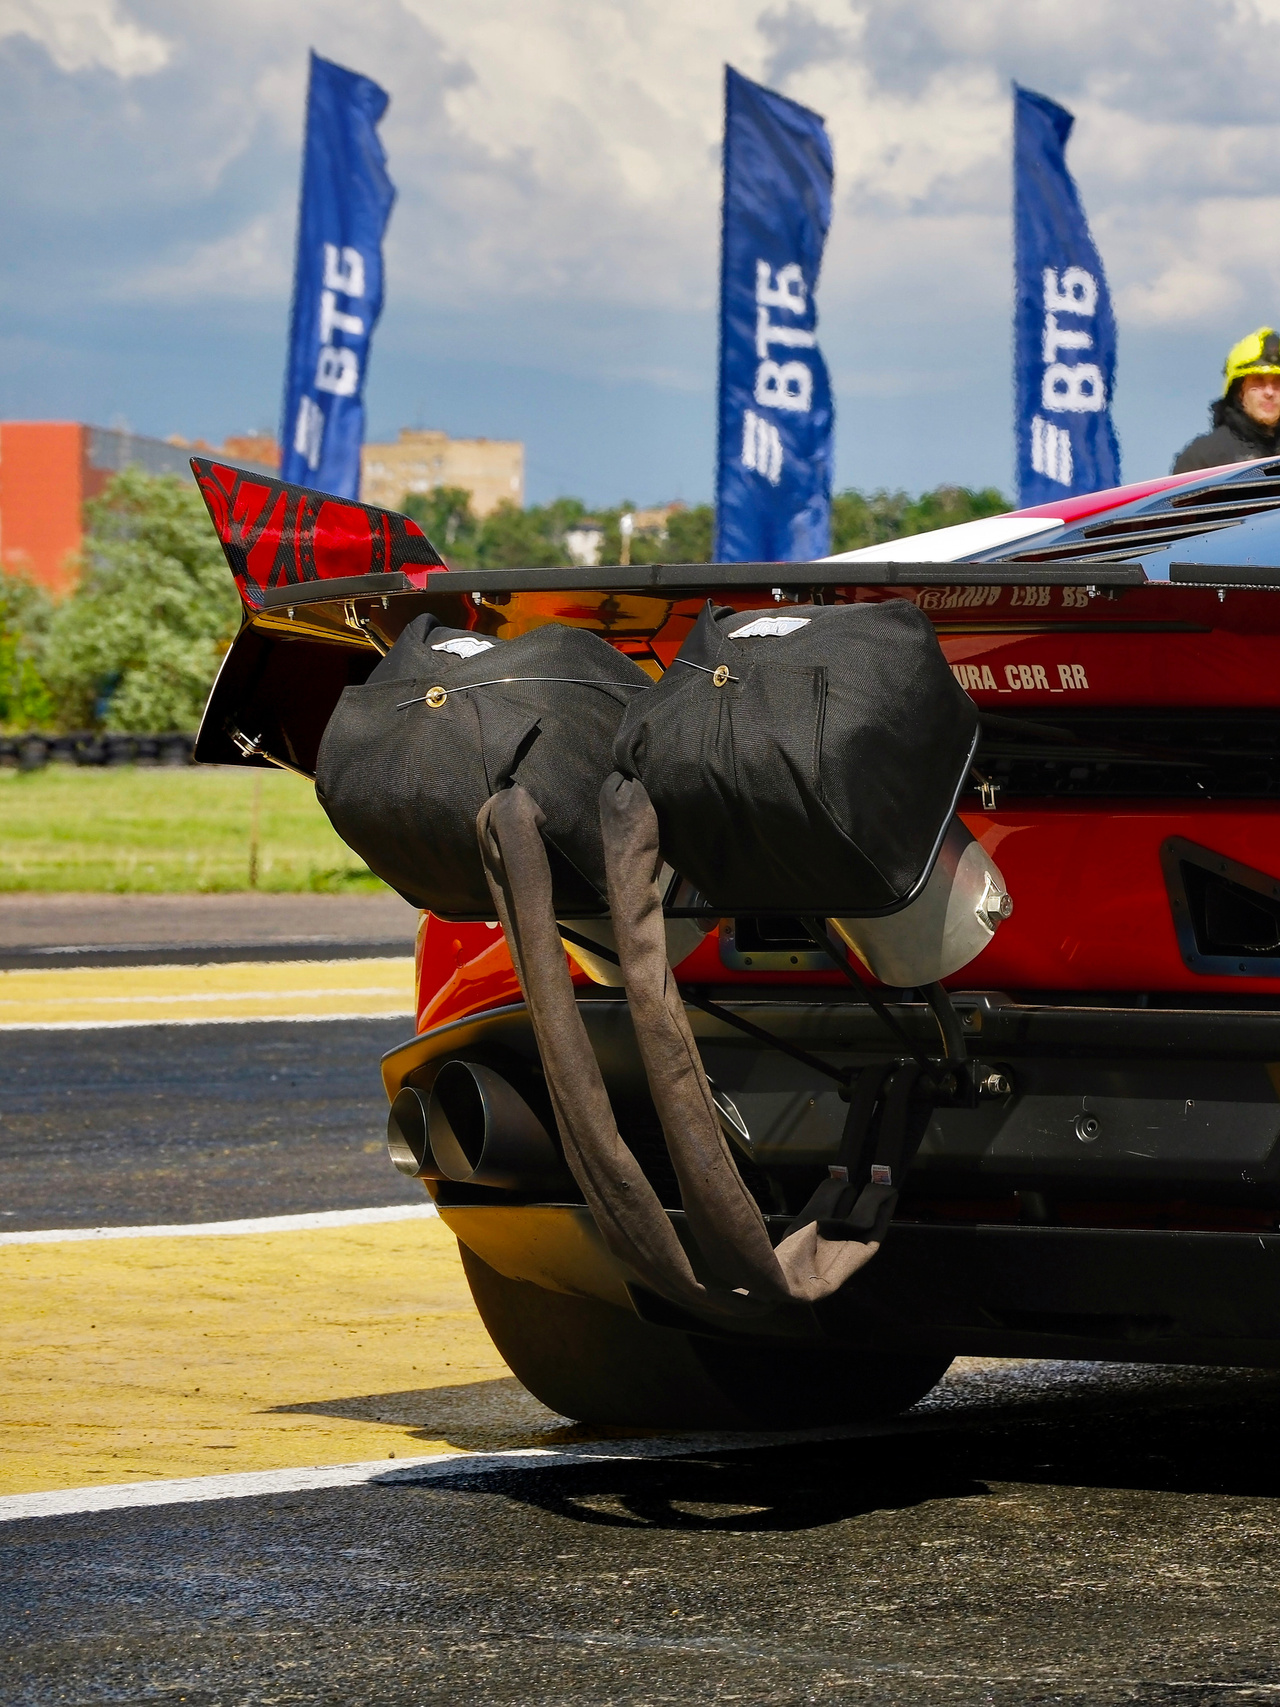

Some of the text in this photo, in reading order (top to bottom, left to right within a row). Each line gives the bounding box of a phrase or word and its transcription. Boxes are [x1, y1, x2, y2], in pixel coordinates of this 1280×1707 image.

[315, 243, 365, 397] ВТБ
[754, 258, 818, 413] ВТБ
[1041, 265, 1107, 412] ВТБ
[948, 663, 1090, 693] URA_CBR_RR
